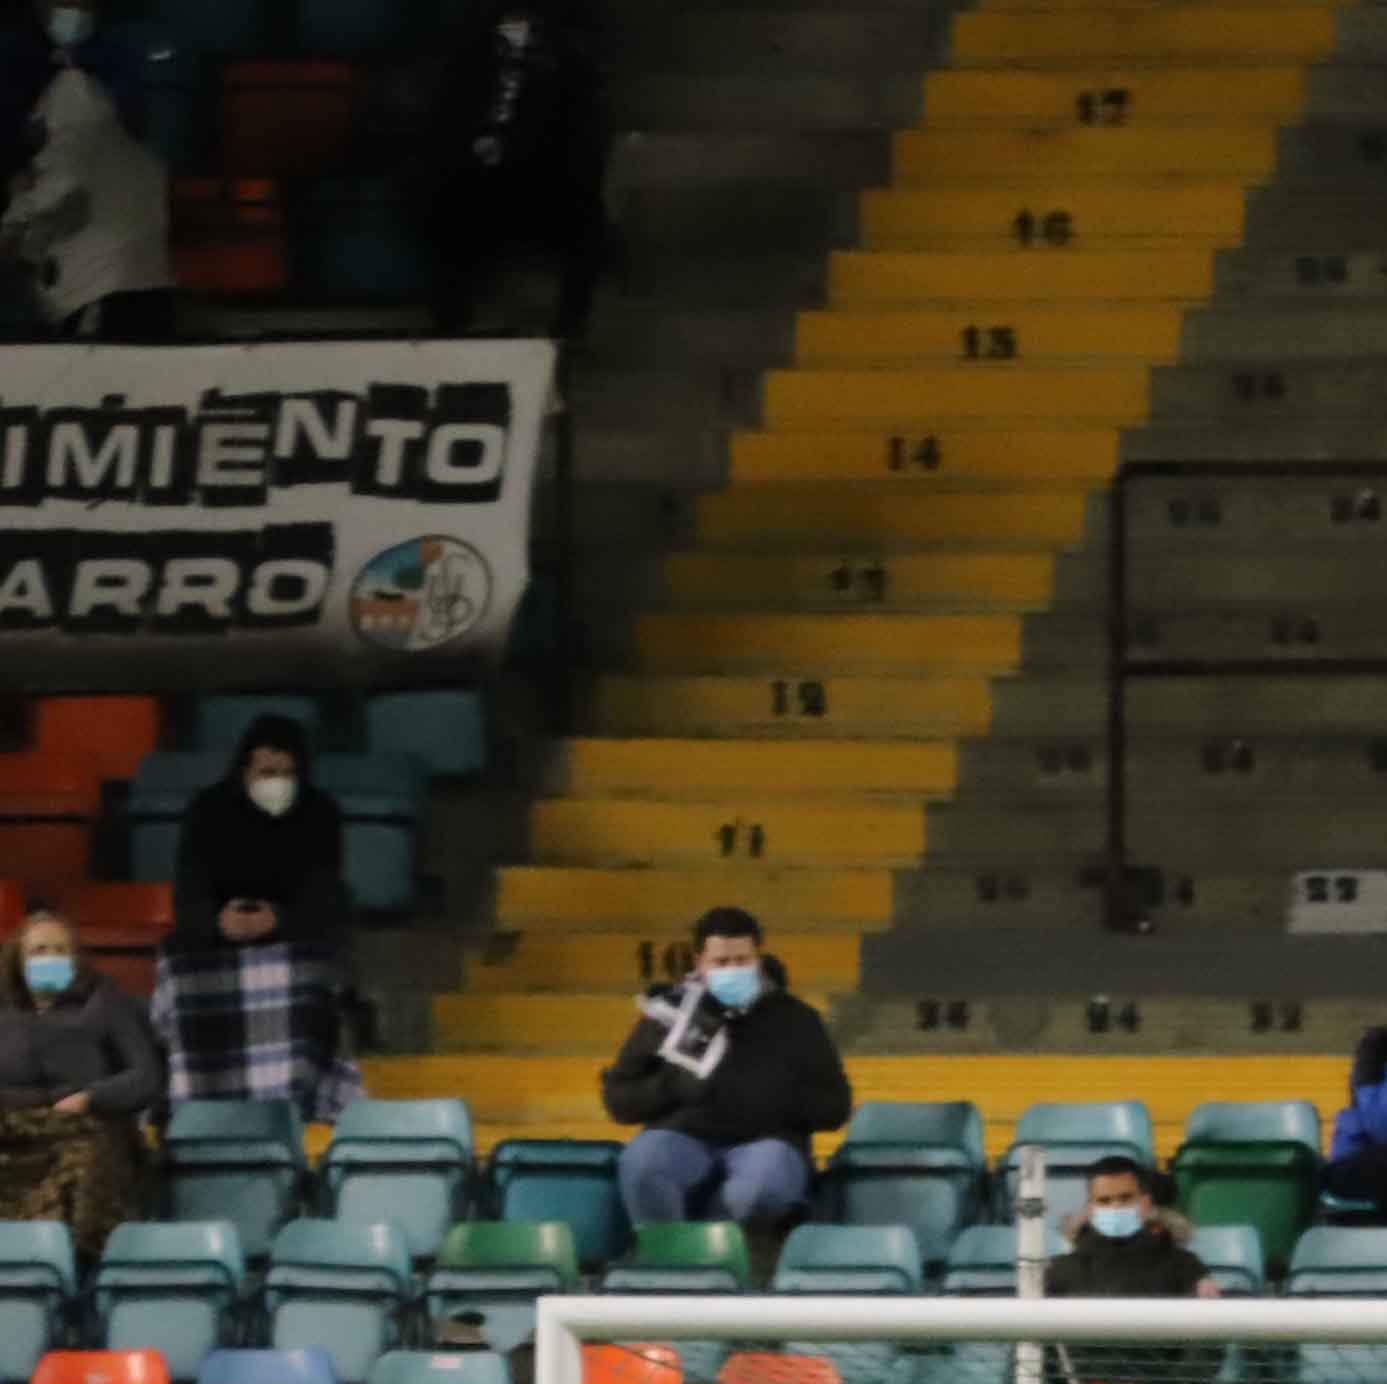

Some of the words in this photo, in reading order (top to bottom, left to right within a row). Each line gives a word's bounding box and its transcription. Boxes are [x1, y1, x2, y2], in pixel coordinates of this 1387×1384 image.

[1012, 208, 1073, 247] 16
[960, 325, 1017, 361] 15
[3, 397, 506, 490] IMIENTO
[887, 436, 942, 472] 14
[0, 557, 330, 618] ARRO
